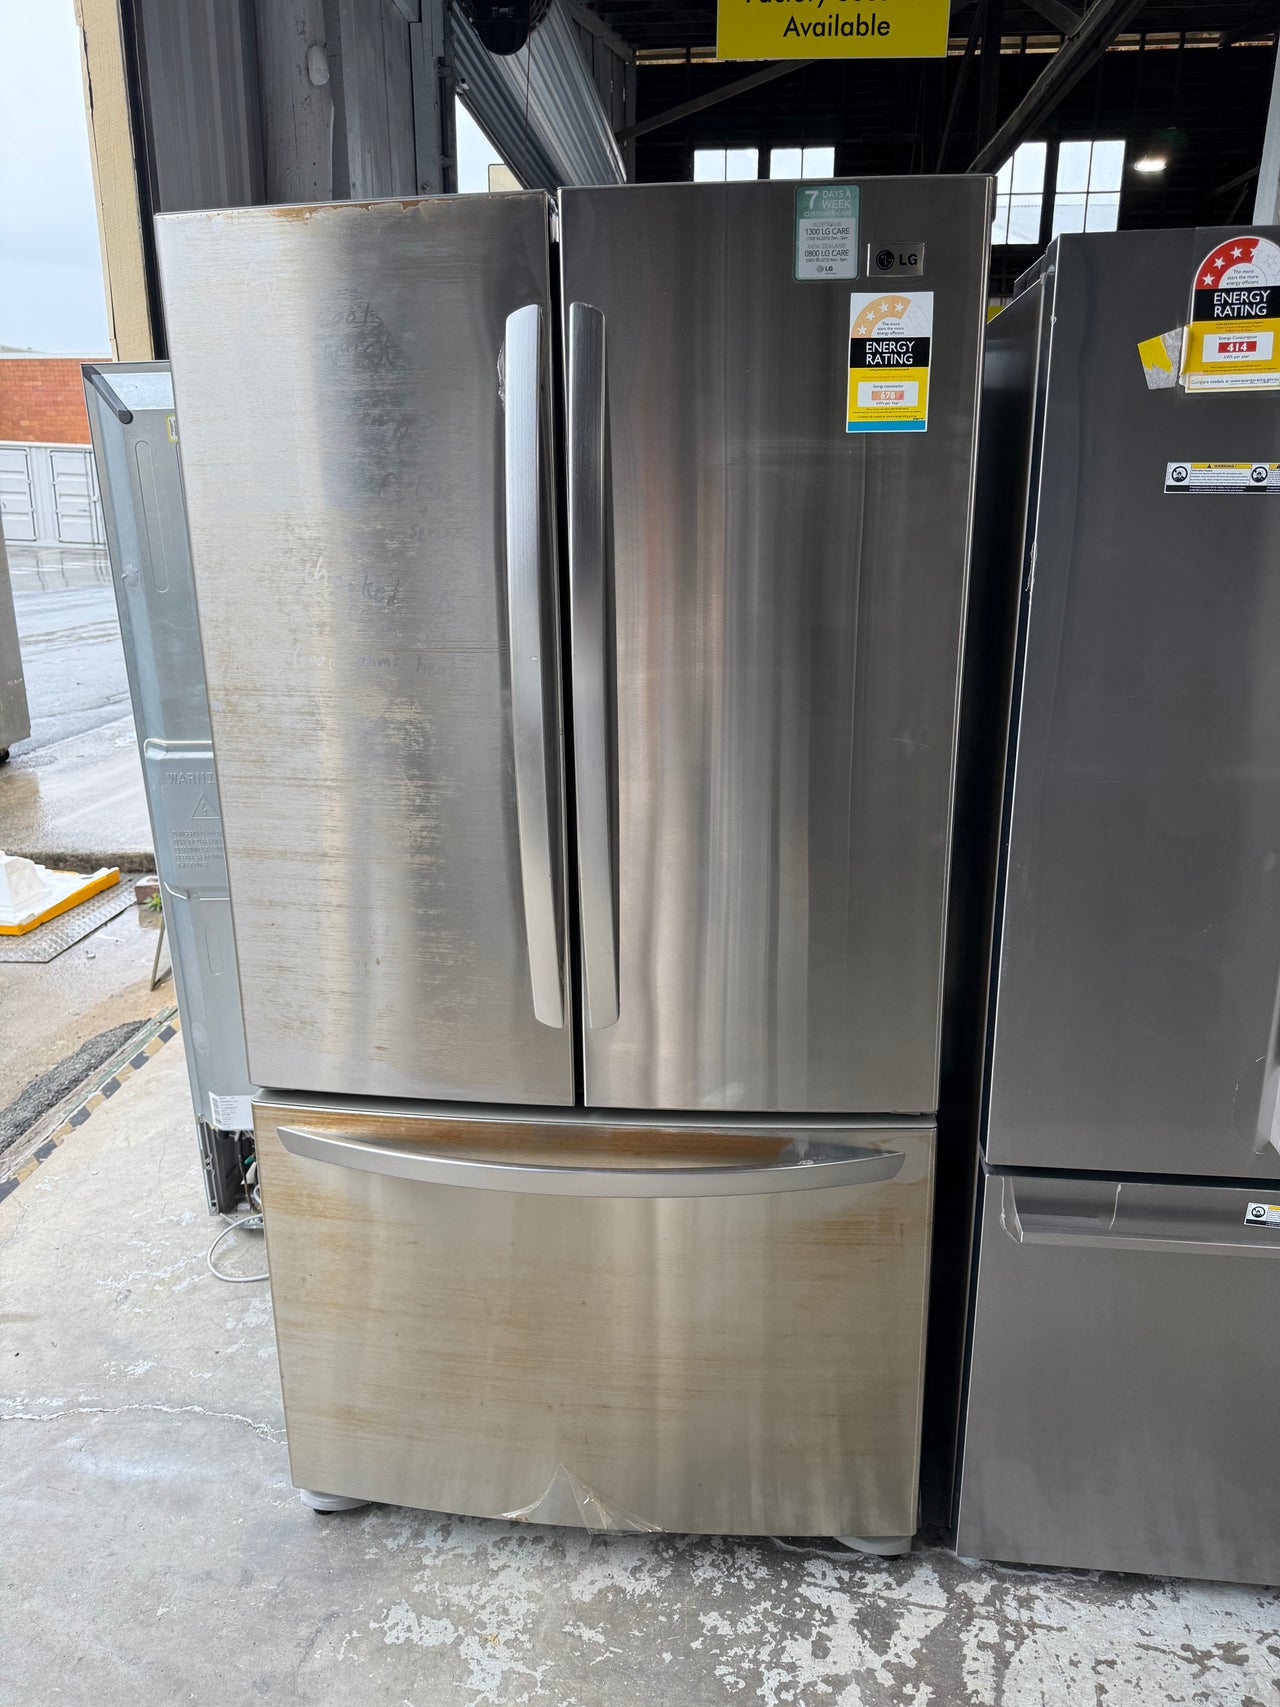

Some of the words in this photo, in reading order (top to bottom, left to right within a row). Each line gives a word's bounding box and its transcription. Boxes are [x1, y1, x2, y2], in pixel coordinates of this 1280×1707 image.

[783, 13, 890, 37] Available
[804, 190, 819, 209] 7
[822, 190, 844, 198] DAYS
[845, 190, 852, 198] A
[822, 199, 852, 209] WEEK
[821, 227, 831, 235] LG
[832, 227, 851, 235] CARE
[831, 249, 850, 257] CARE
[899, 253, 918, 266] LG
[1213, 290, 1271, 305] ENERGY
[1213, 304, 1267, 318] RATING
[866, 340, 915, 353] ENERGY
[1227, 343, 1248, 352] 414
[866, 353, 913, 365] RATING
[880, 391, 896, 399] 678
[166, 771, 216, 785] WARNI
